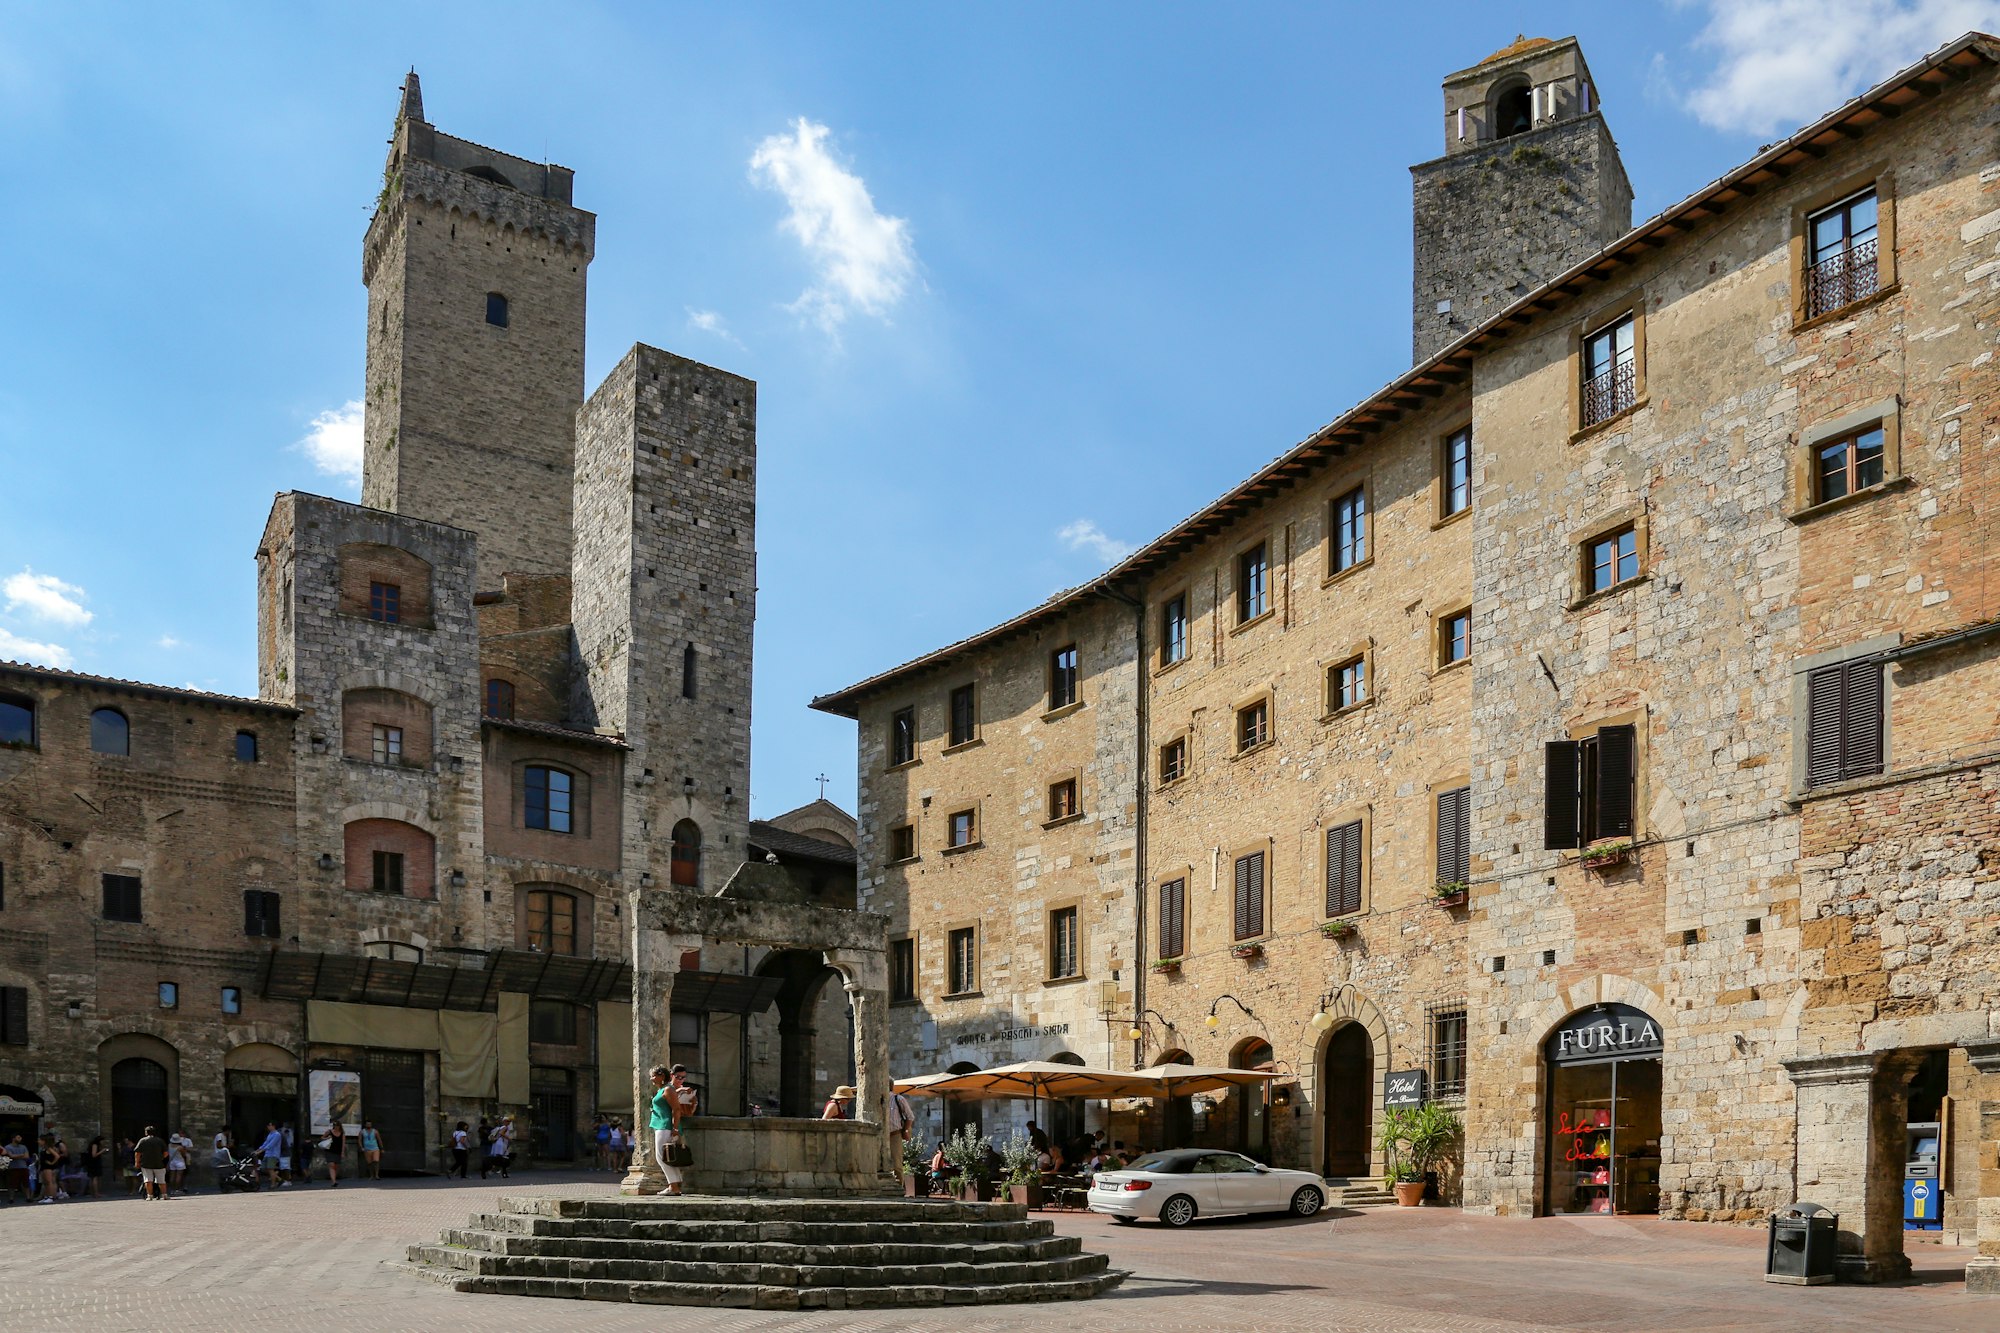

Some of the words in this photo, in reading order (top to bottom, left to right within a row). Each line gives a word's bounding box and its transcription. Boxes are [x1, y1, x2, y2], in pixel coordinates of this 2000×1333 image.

[1043, 1023, 1069, 1036] SIENA
[1558, 1020, 1659, 1052] FURLA
[1388, 1078, 1418, 1094] Hotel
[1553, 1112, 1597, 1135] Sale
[1566, 1138, 1610, 1161] Sale
